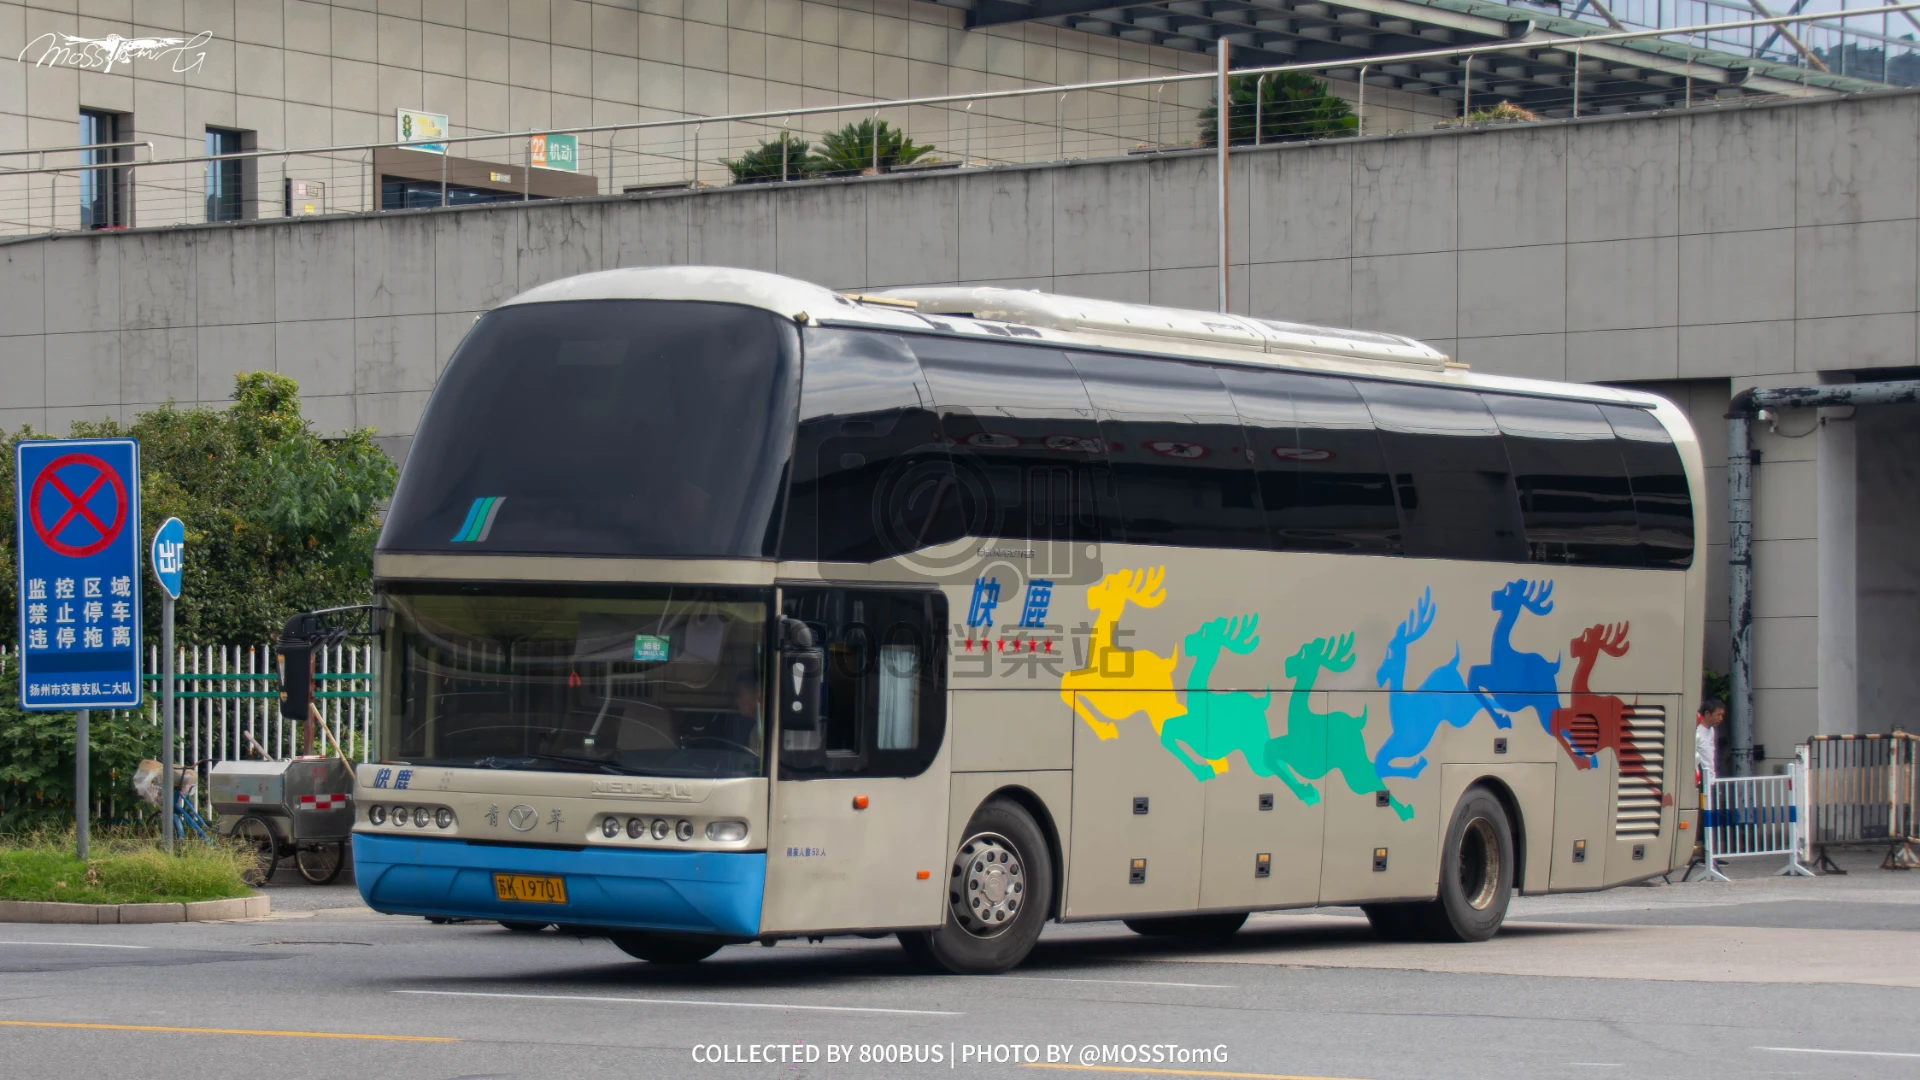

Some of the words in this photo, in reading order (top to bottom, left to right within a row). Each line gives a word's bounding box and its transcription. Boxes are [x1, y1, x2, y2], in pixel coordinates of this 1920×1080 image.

[532, 138, 545, 160] 22
[550, 142, 572, 162] 机动
[28, 576, 131, 600] 监控区域
[28, 601, 131, 625] 禁止停车
[966, 576, 1054, 628] 快鹿
[29, 625, 131, 649] 违停拖离
[29, 682, 132, 697] 扬州市交警支队二大队
[373, 768, 413, 790] 快鹿
[591, 779, 693, 801] NEOPLAN
